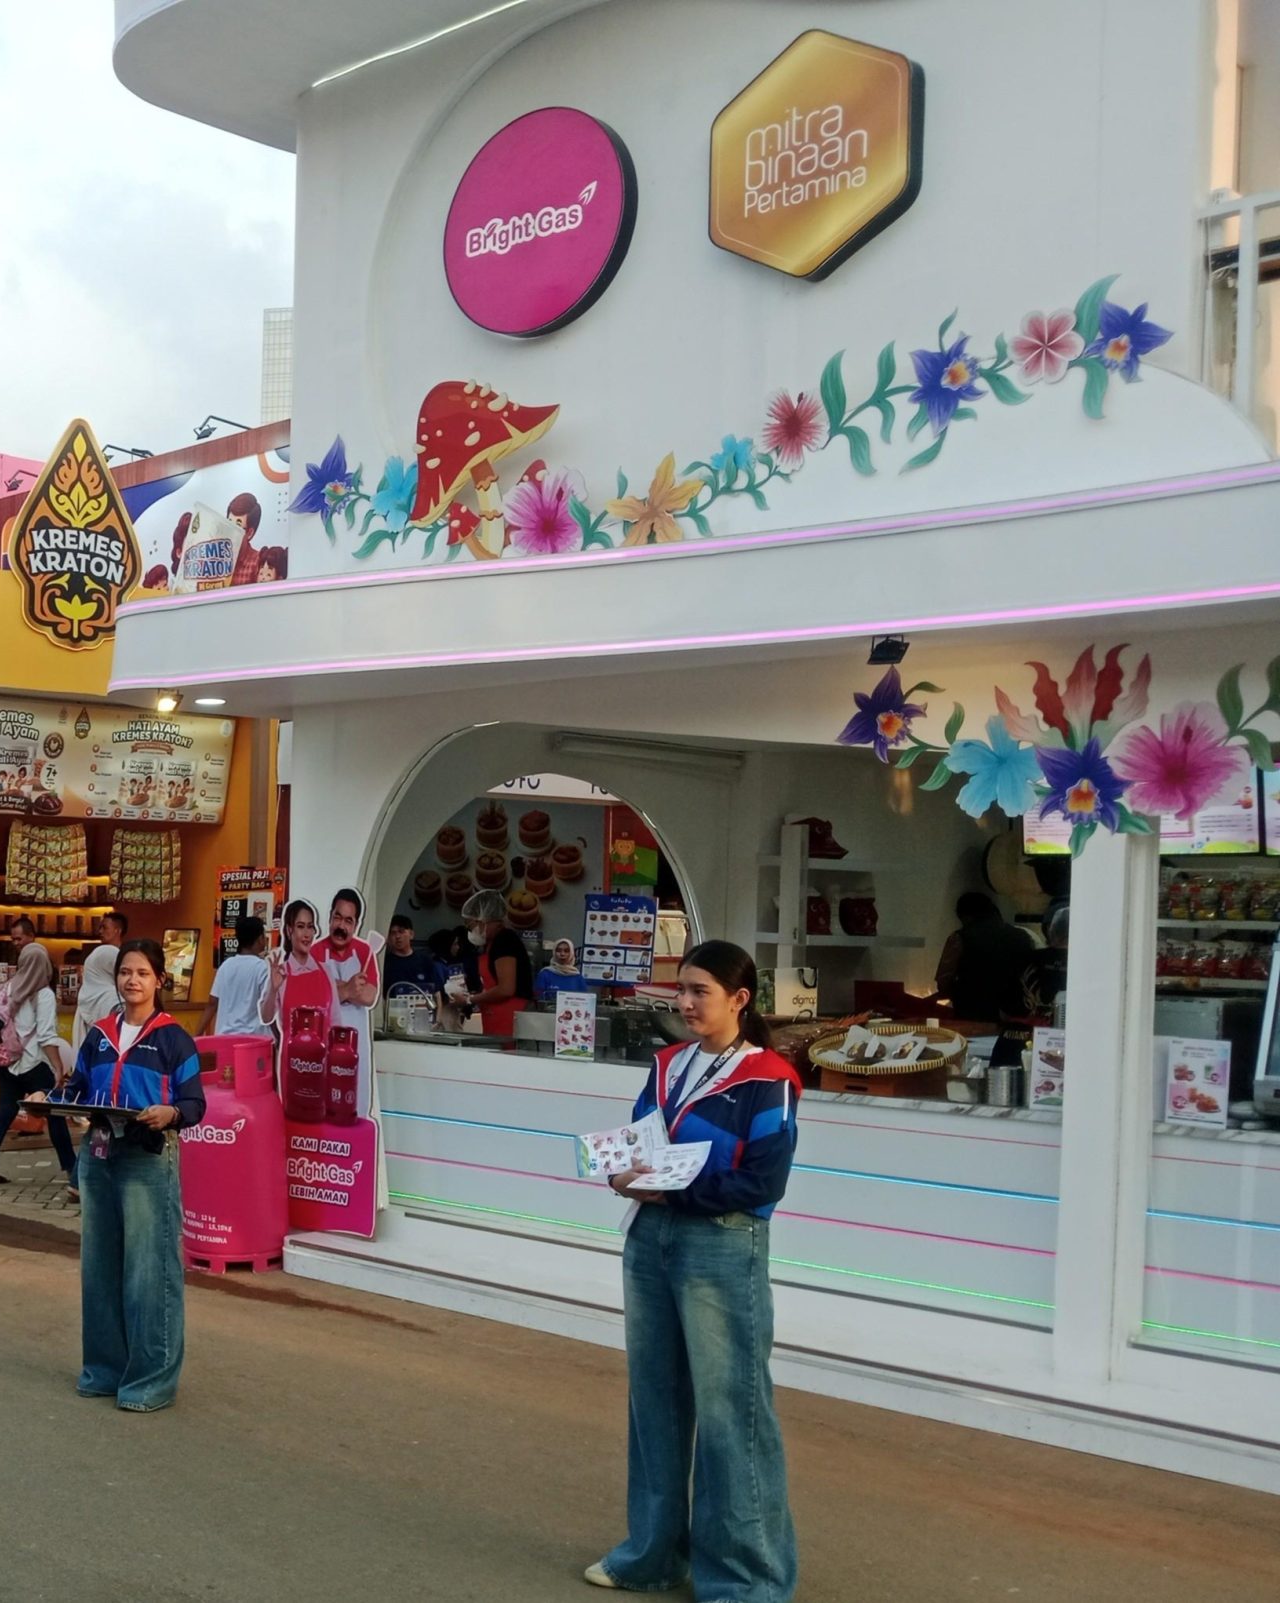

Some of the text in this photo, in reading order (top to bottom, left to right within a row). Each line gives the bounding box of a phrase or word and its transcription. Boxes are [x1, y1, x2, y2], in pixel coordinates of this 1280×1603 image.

[746, 104, 843, 158] mitra
[745, 128, 868, 190] binaan
[744, 165, 867, 218] Pertamina
[466, 207, 583, 258] Bright Gas
[31, 529, 123, 562] KREMES
[185, 541, 233, 561] KREMES
[28, 552, 125, 585] KRATON
[185, 561, 233, 578] KRATON
[3, 723, 40, 741] Ayam
[129, 721, 180, 735] HATI AYAM
[113, 731, 194, 748] KREMES KRATON?
[45, 767, 58, 778] 7+
[222, 870, 269, 881] SPESIAL PRJ!
[226, 900, 240, 910] 50
[223, 939, 239, 948] 100
[713, 1046, 737, 1069] RIDER
[203, 1128, 235, 1143] Gas
[291, 1137, 350, 1155] KAMI PAKAI
[287, 1158, 354, 1184] Bright Gas
[290, 1186, 348, 1204] LEBIH AMAN
